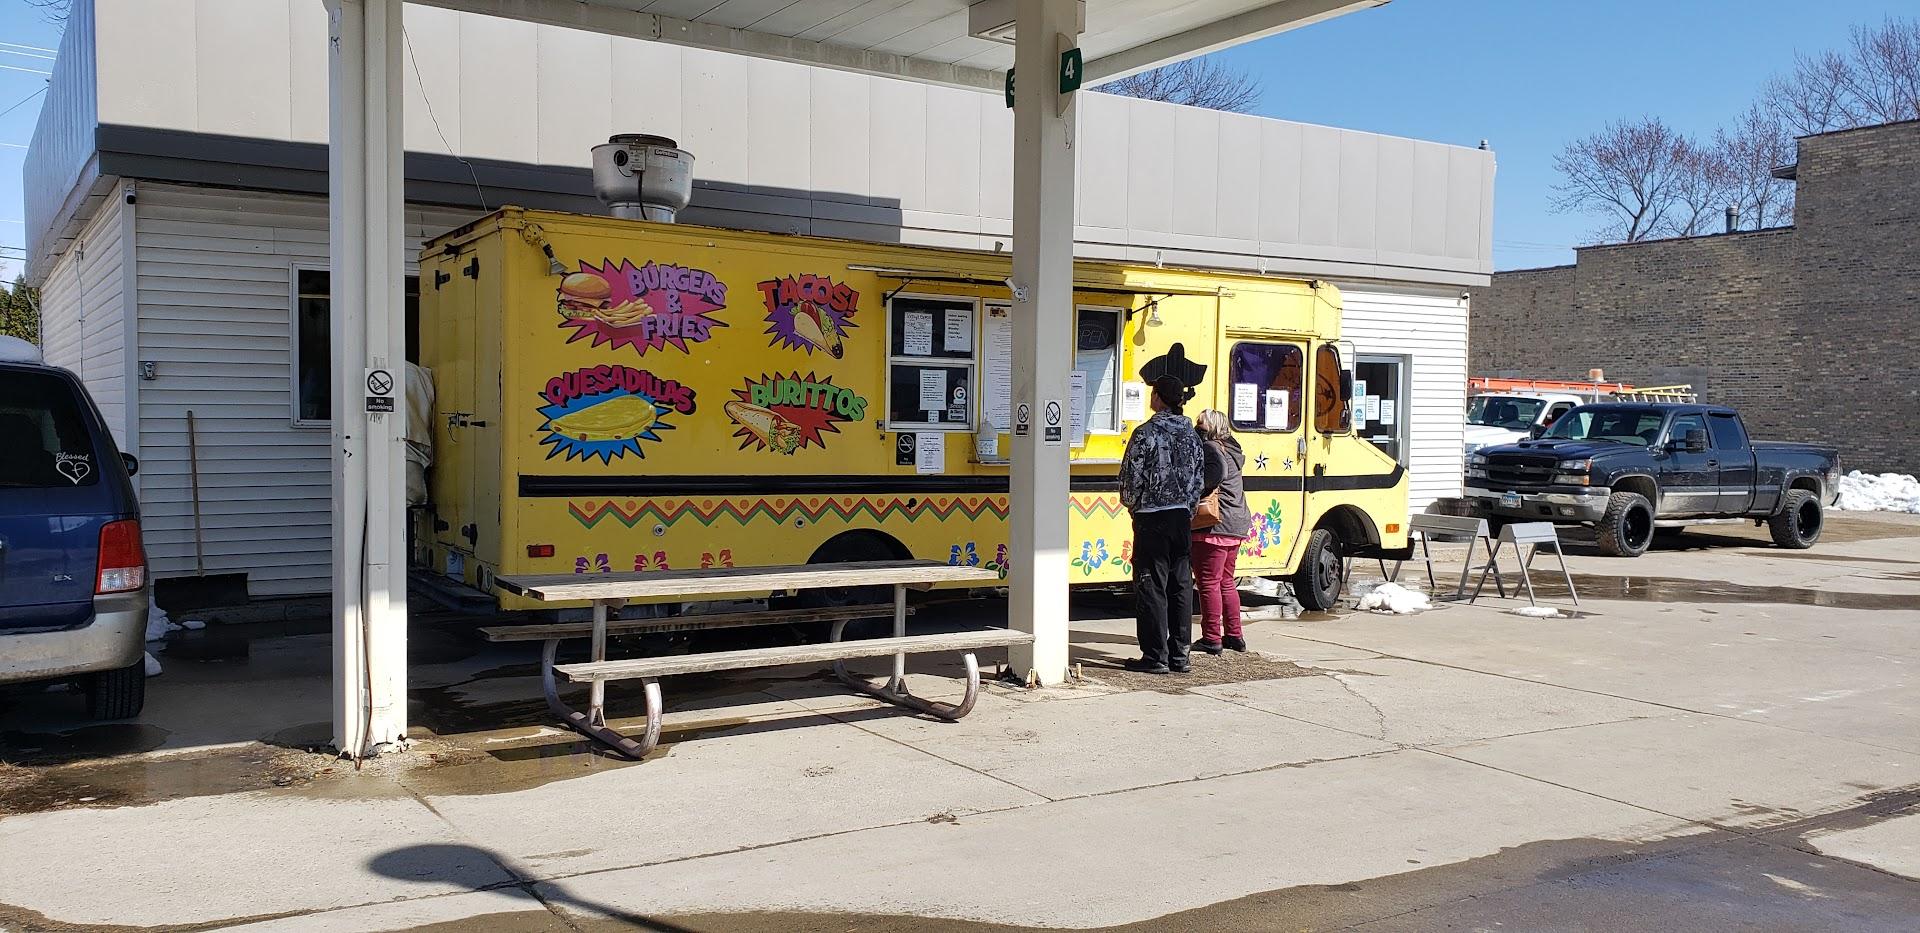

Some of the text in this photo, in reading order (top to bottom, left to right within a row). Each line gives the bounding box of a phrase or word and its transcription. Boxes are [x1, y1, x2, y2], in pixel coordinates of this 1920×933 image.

[1064, 56, 1075, 80] 4
[627, 264, 728, 305] BURGERS
[665, 289, 682, 313] &
[757, 274, 860, 318] TACOS!
[642, 313, 711, 342] FRIES
[545, 365, 697, 415] QUESADILLAS
[751, 379, 869, 422] BURITTOS
[56, 451, 89, 462] Blessed
